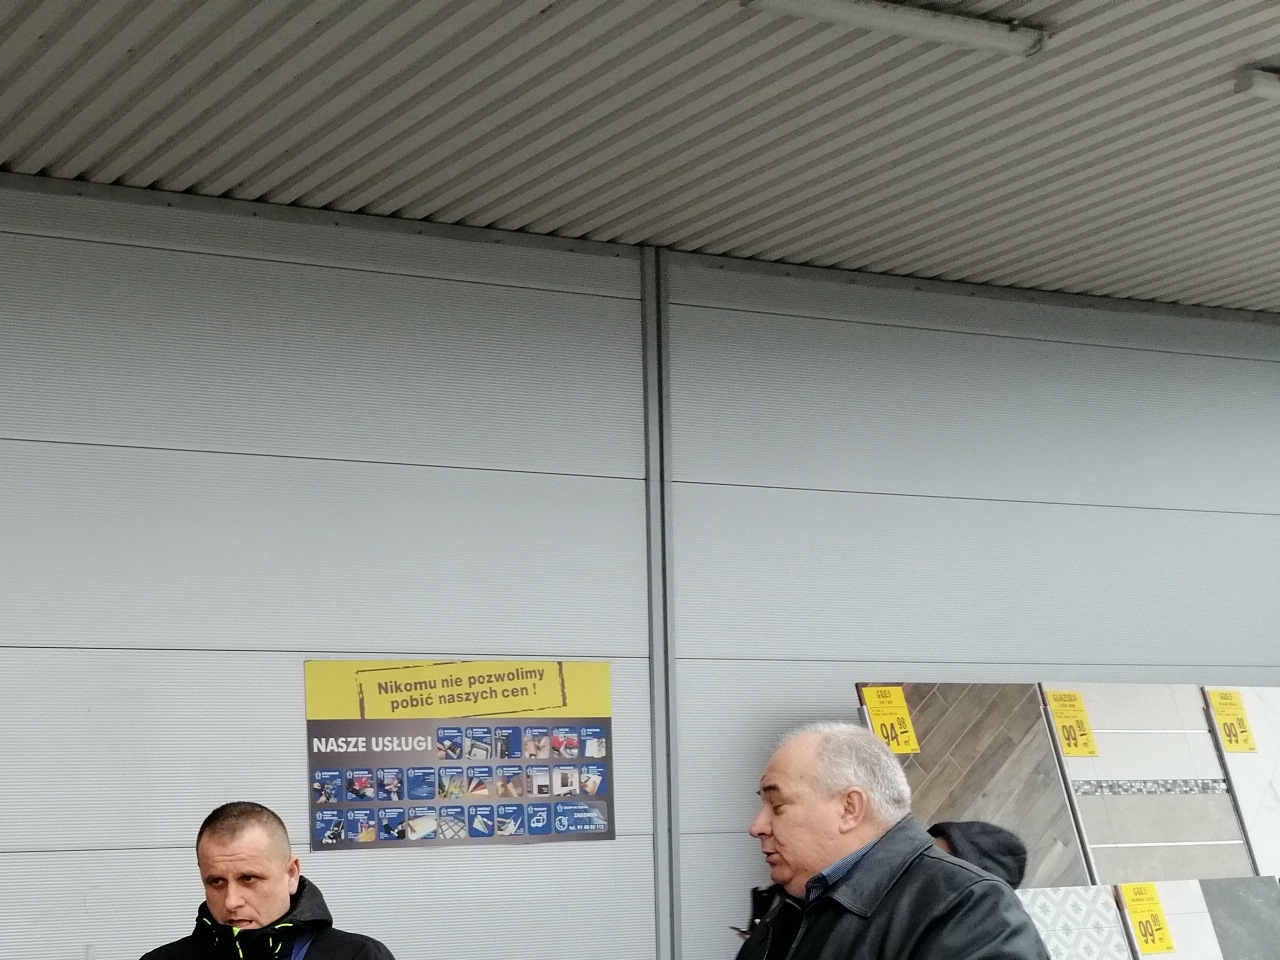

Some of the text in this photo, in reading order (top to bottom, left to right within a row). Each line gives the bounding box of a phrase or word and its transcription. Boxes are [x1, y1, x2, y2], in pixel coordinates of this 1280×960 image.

[377, 667, 545, 695] Nikomu nie pozwolimy
[390, 693, 434, 712] pobić
[438, 687, 498, 705] naszych
[501, 685, 529, 698] cen
[313, 736, 432, 752] NASZE USŁUGI
[880, 722, 900, 746] 94
[1061, 724, 1078, 748] 99
[1223, 722, 1239, 744] 99
[1138, 919, 1155, 945] 99
